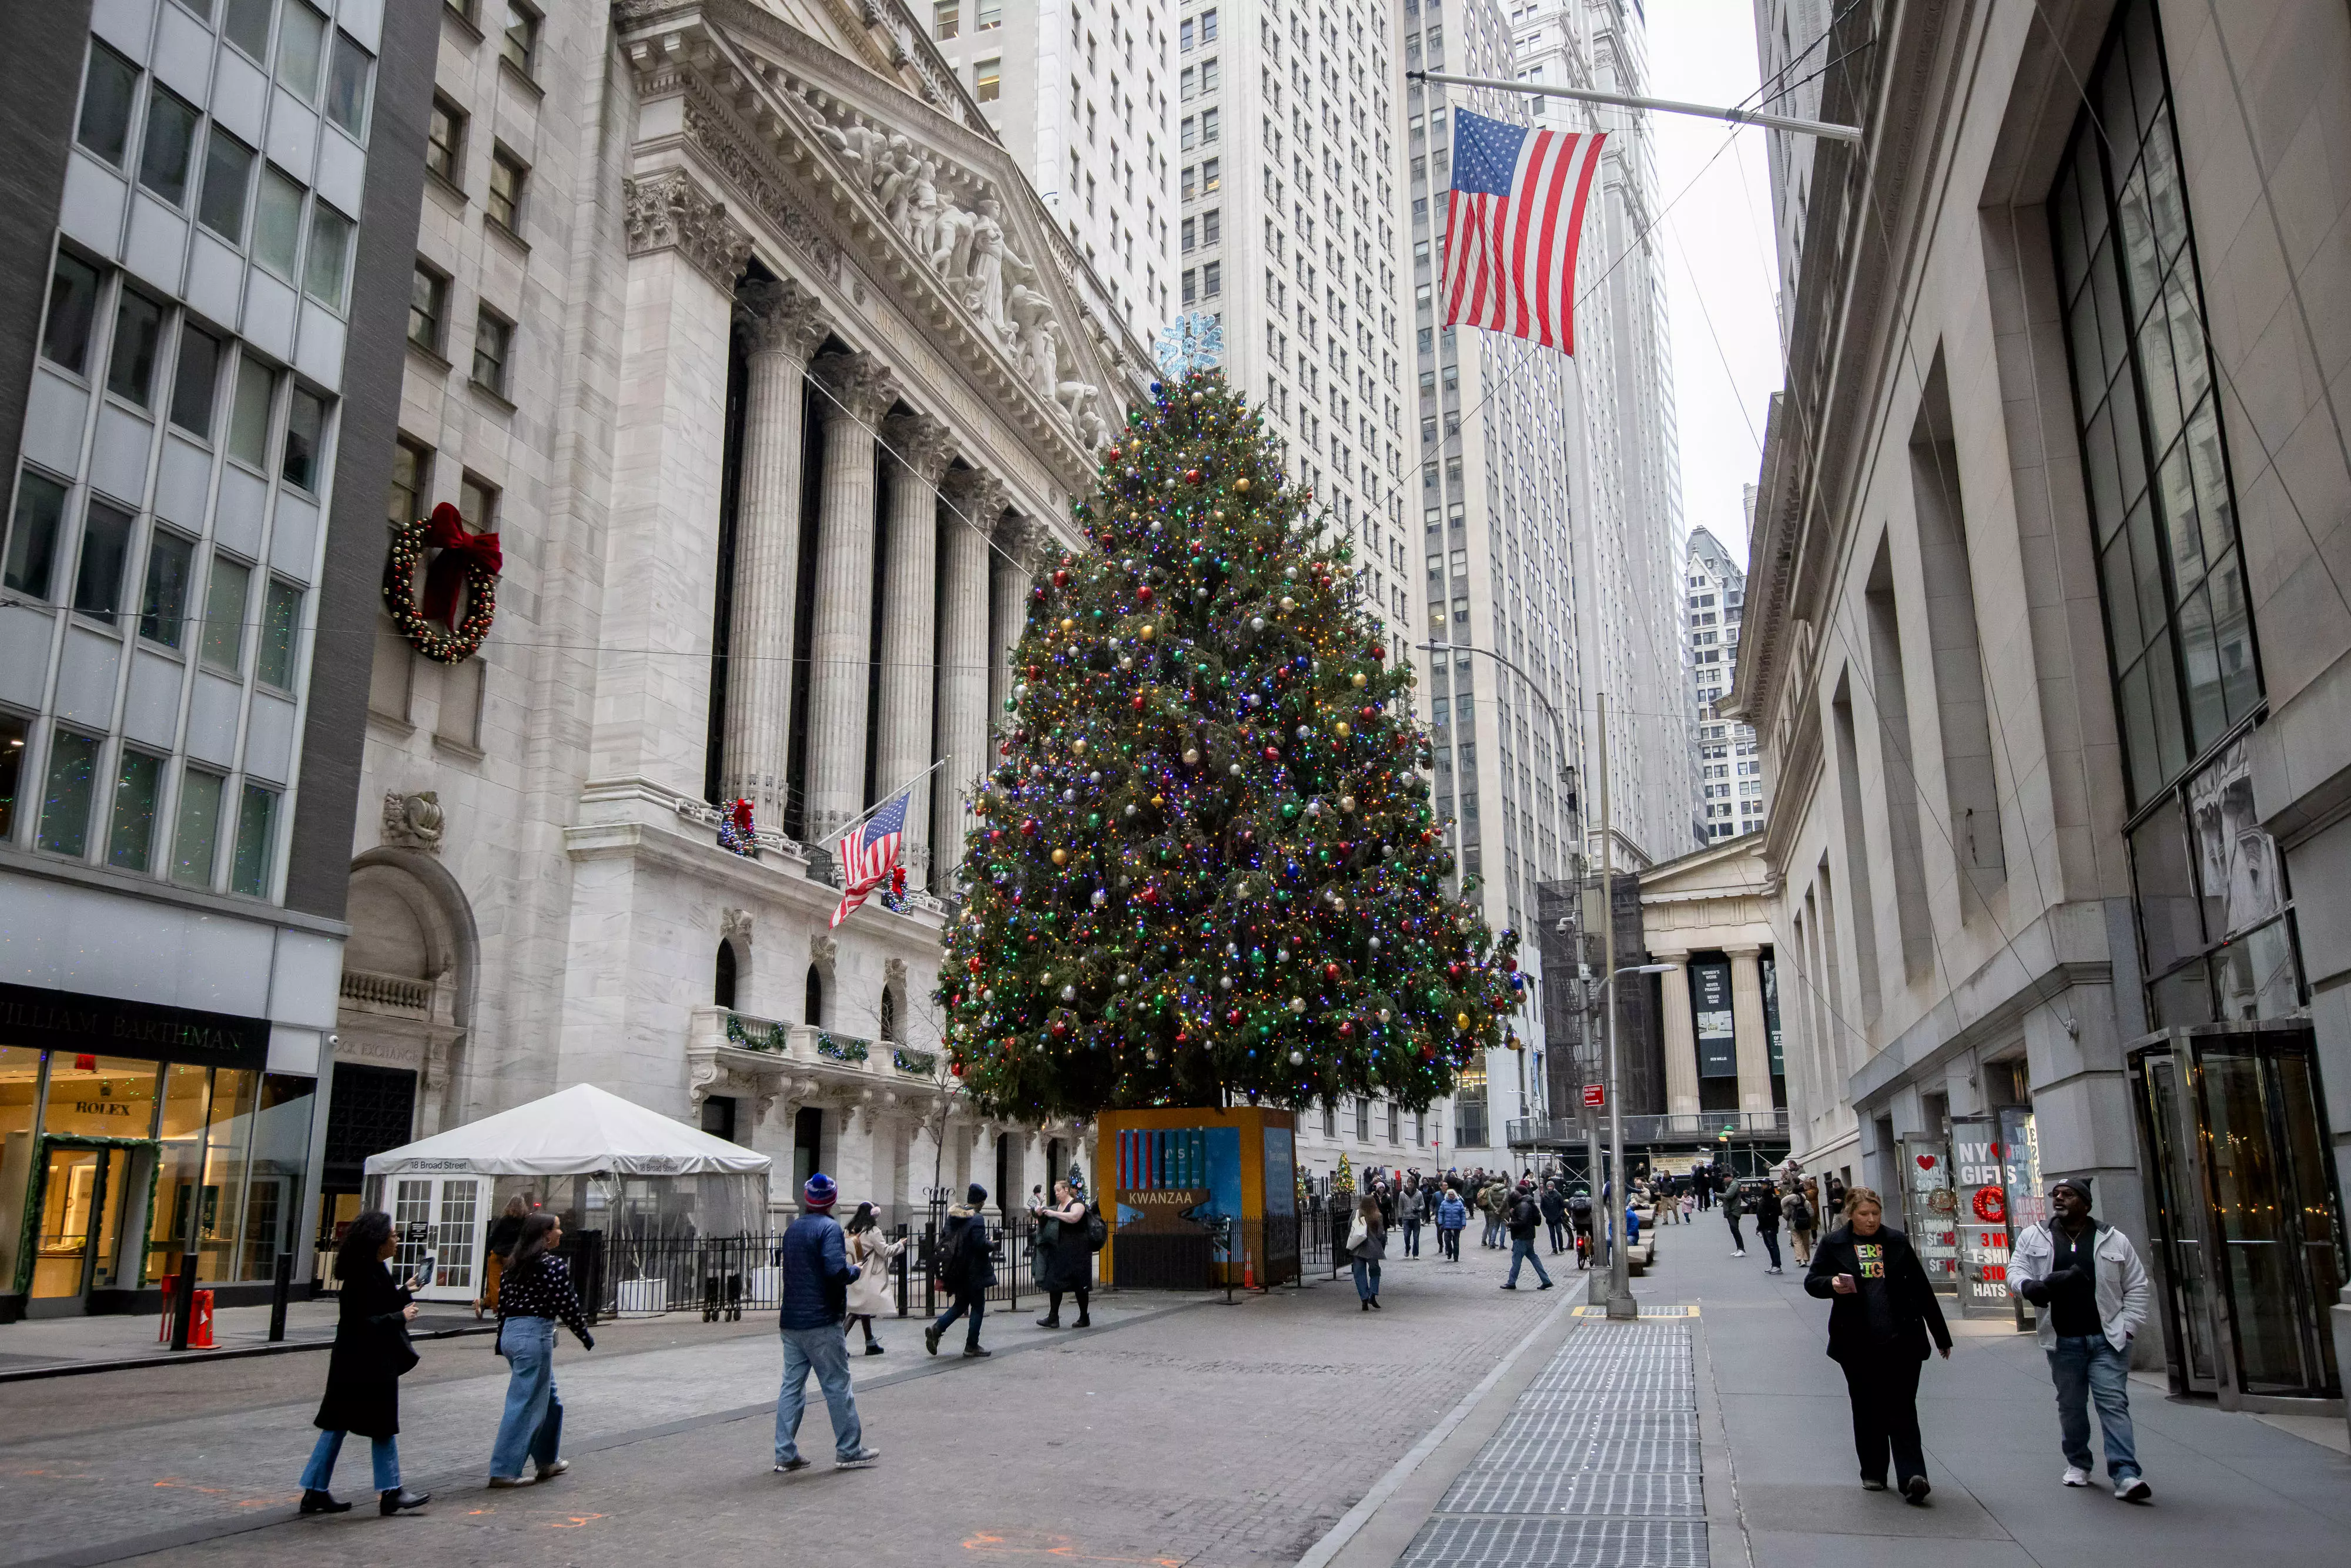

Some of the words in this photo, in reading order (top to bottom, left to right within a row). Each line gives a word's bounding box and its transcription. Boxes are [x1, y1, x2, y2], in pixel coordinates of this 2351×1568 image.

[875, 304, 903, 346] NEW
[911, 341, 943, 391] YORK
[950, 384, 984, 433] STOCK
[990, 424, 1041, 491] EXCHANGE
[0, 1001, 98, 1035] ILLIAM
[111, 1016, 245, 1051] BARTHMAN
[361, 1043, 419, 1063] EXCHANGE
[75, 1101, 132, 1116] ROLEX
[1958, 1143, 1988, 1162] NY
[639, 1164, 645, 1172] 18
[647, 1164, 661, 1172] Broad
[1961, 1165, 2017, 1184] GIFTS
[1129, 1192, 1193, 1204] KWANZAA
[1981, 1233, 1989, 1247] 3
[1971, 1249, 2010, 1264] T-SHI
[1982, 1265, 2006, 1281] $10
[1973, 1284, 2007, 1298] HATS
